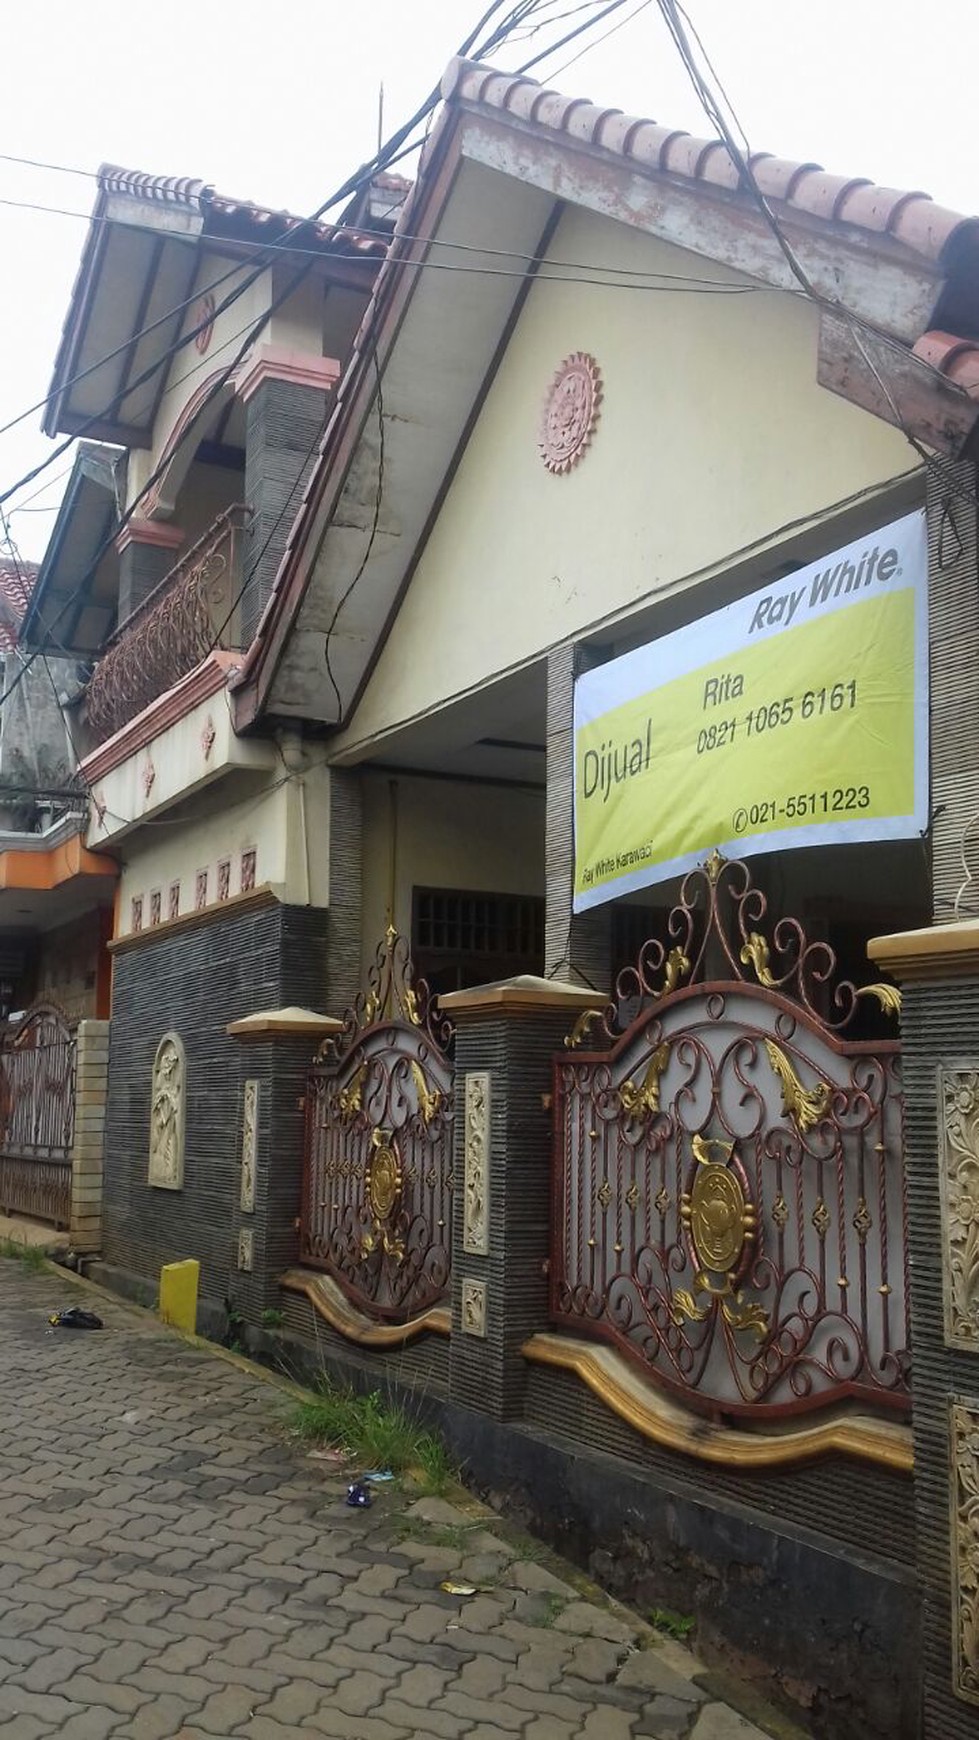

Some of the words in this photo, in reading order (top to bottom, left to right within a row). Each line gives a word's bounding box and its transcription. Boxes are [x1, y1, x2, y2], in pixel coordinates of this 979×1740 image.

[748, 584, 807, 635] Ray
[808, 546, 899, 609] White
[696, 717, 737, 755] 0821
[745, 696, 795, 737] 1065
[801, 679, 857, 720] 6161
[702, 673, 745, 711] Rita
[583, 717, 652, 804] Dijual
[749, 785, 871, 825] 021-5511223
